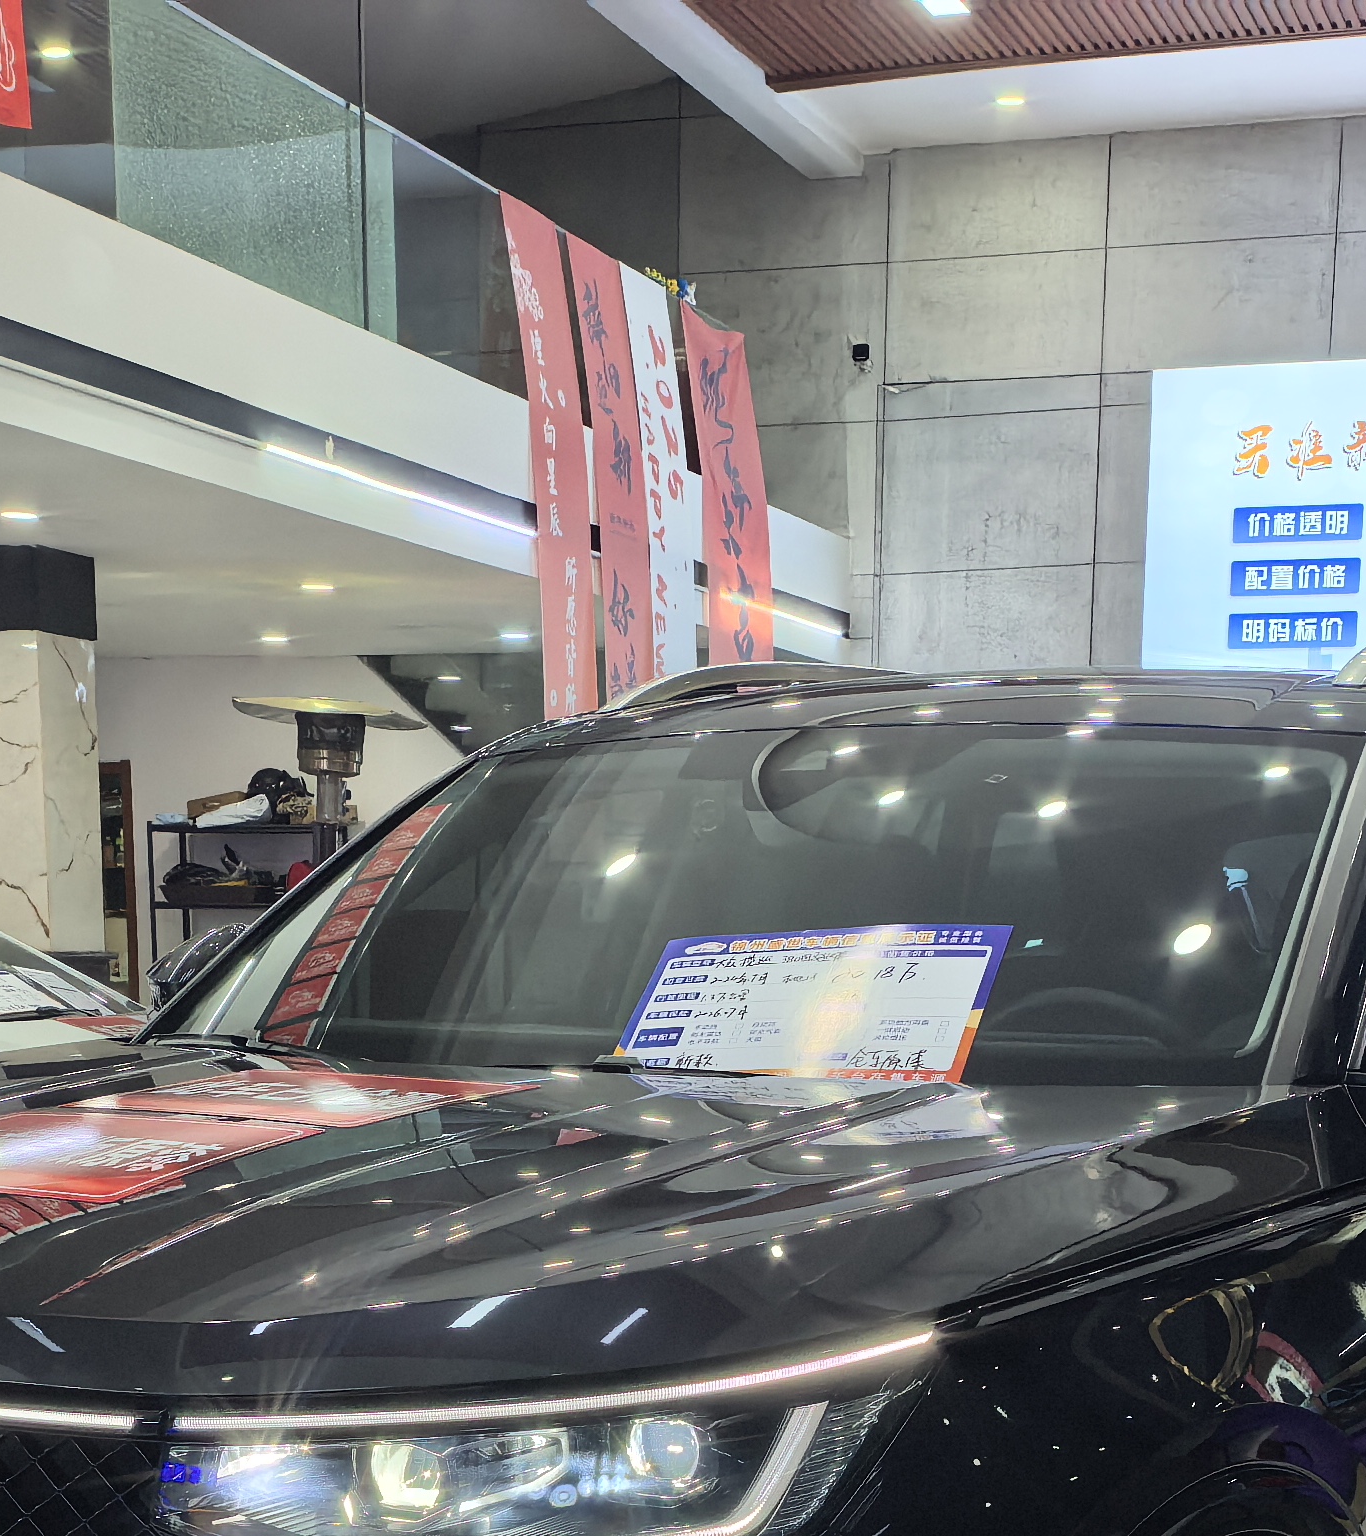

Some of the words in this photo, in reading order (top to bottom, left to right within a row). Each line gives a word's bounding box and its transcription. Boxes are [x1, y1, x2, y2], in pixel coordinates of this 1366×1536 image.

[1247, 509, 1350, 538] 价格透明
[1244, 563, 1347, 591] 配置价格
[1241, 617, 1344, 643] 明码标价
